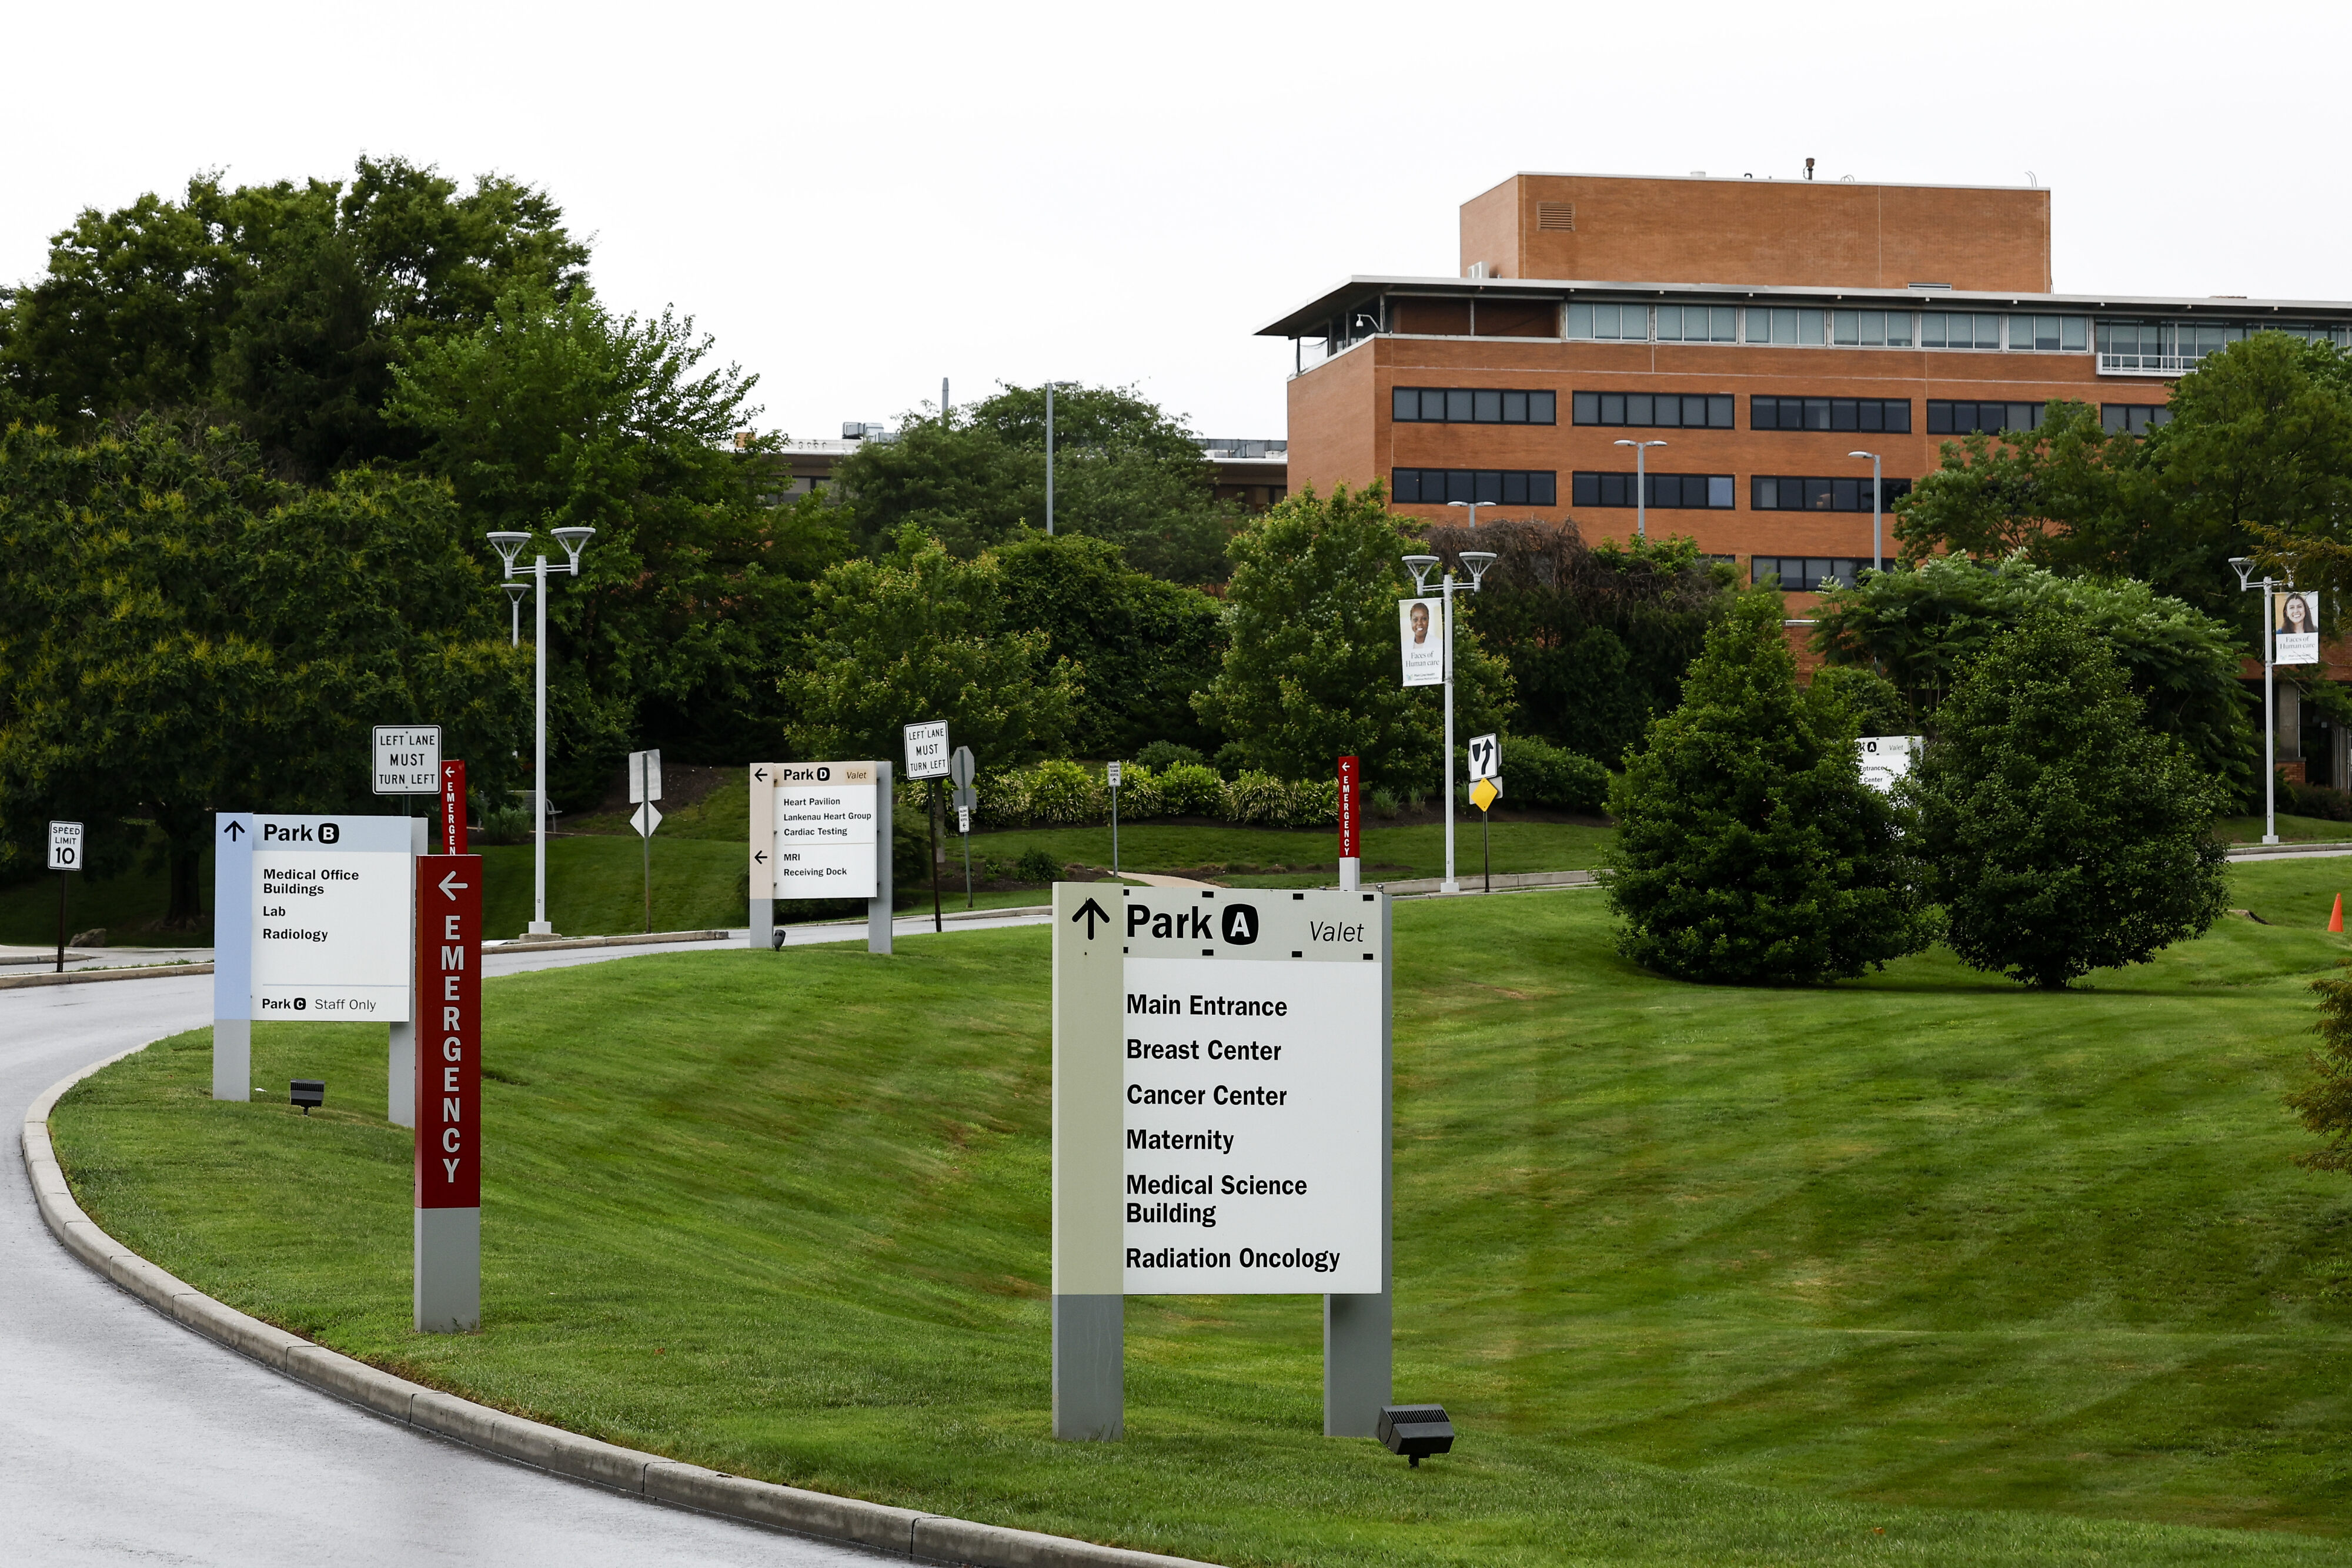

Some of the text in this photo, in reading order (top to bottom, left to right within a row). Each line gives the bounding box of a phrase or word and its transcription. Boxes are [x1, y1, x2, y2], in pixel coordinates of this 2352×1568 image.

[380, 735, 435, 746] LEFT LANE
[908, 728, 944, 741] LEFT LANE
[916, 743, 938, 756] MUST
[390, 753, 425, 766] MUST
[910, 759, 946, 772] TURN LEFT
[379, 774, 435, 785] TURN LEFT
[784, 768, 827, 781] Park D
[846, 771, 867, 780] Valet
[809, 797, 840, 805] Pavilion
[446, 781, 456, 855] EMERGEN
[784, 813, 821, 821] Lankenau
[848, 812, 871, 821] Group
[52, 826, 81, 835] SPEED
[264, 823, 335, 841] Park B
[784, 827, 848, 837] Cardiac Testing
[55, 837, 76, 845] LIMIT
[55, 847, 75, 865] 10
[784, 853, 800, 861] MRI
[263, 868, 359, 880] Medical Office
[784, 867, 847, 877] Receiving Dock
[263, 883, 325, 897] Buildings
[263, 905, 286, 917] Lab
[1127, 904, 1251, 940] Park A
[263, 928, 328, 942] Radiology
[1310, 921, 1365, 942] Valet
[262, 998, 303, 1009] Park C
[315, 999, 376, 1012] Staff Only
[1127, 994, 1288, 1017] Main Entrance
[441, 915, 465, 1183] EMERGENCY
[1127, 1038, 1282, 1061] Breast Center
[1127, 1084, 1287, 1106] Cancer Center
[1127, 1129, 1234, 1155] Maternity
[1127, 1174, 1307, 1195] Medical Science
[1127, 1202, 1217, 1228] Building
[1126, 1247, 1341, 1273] Radiation Oncology
